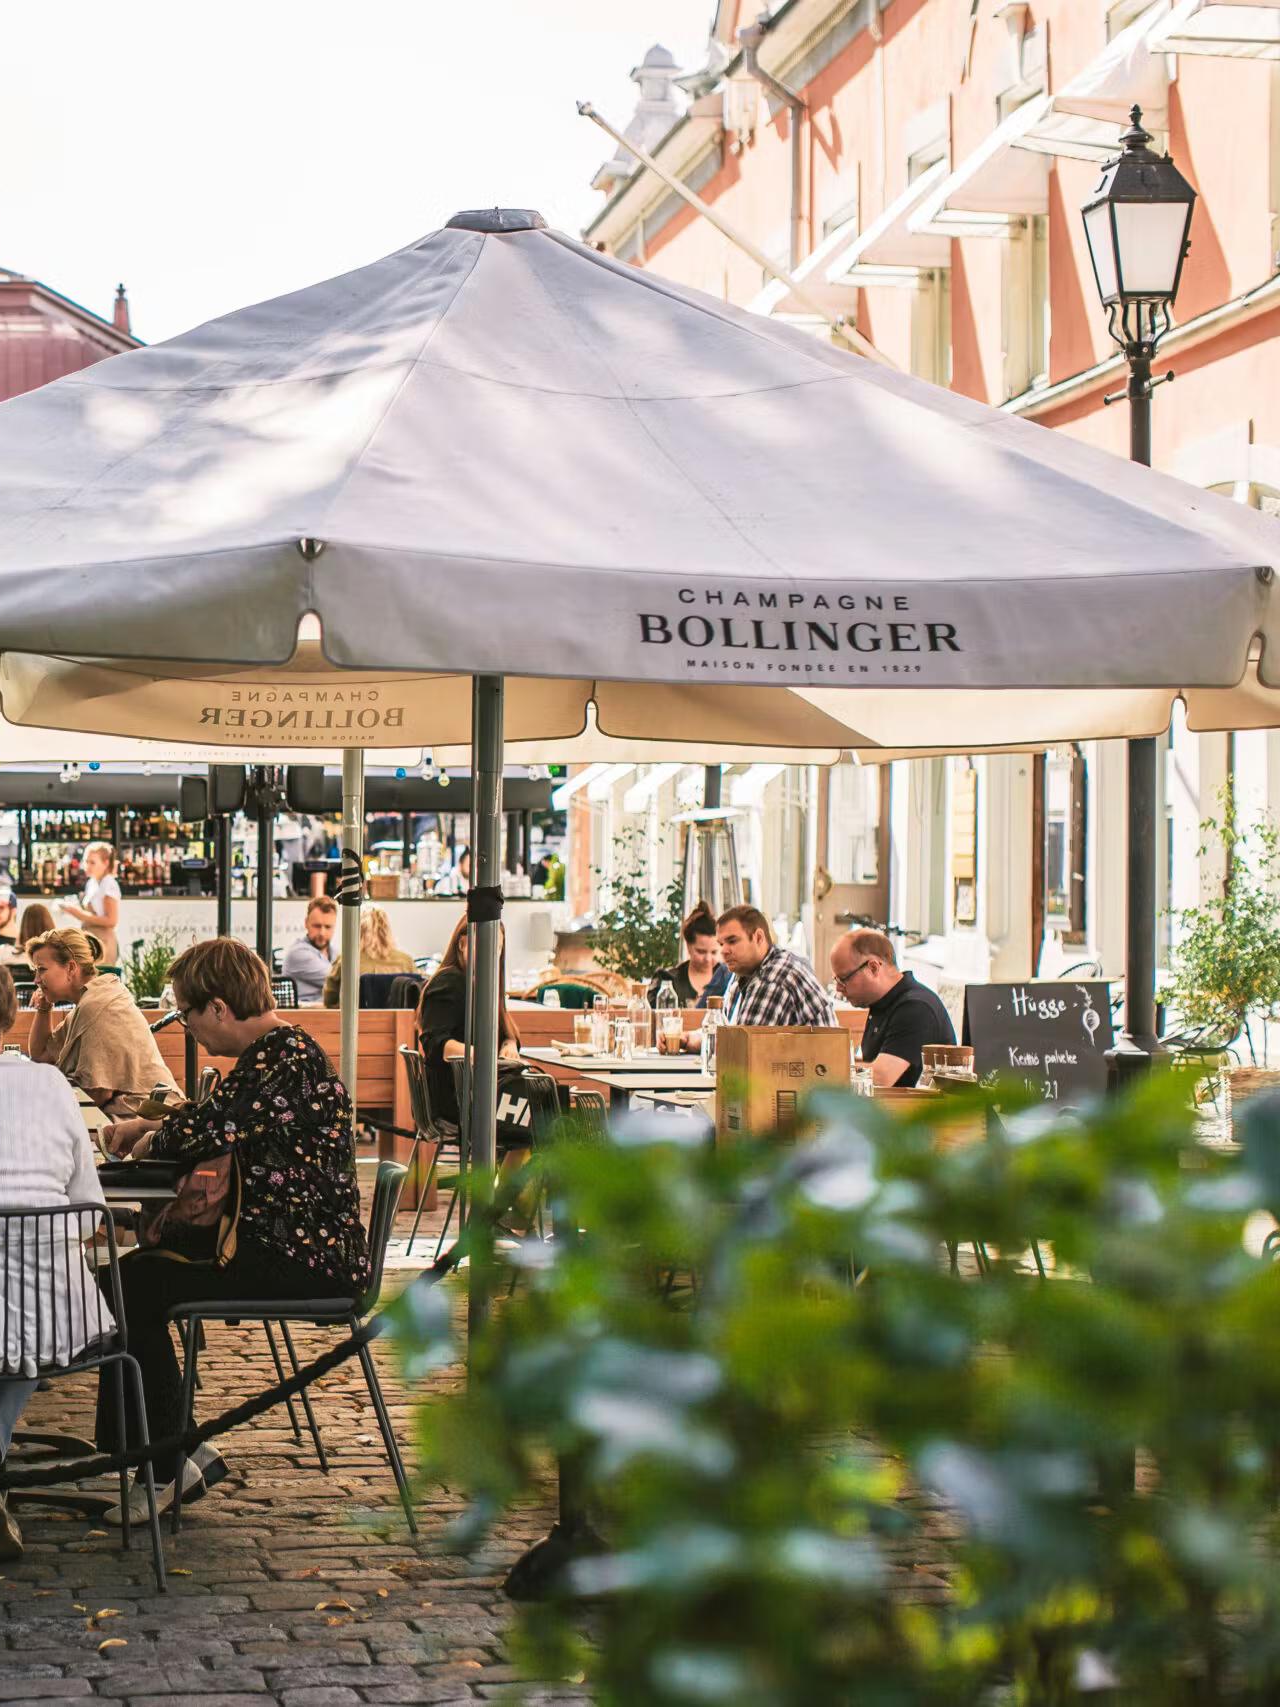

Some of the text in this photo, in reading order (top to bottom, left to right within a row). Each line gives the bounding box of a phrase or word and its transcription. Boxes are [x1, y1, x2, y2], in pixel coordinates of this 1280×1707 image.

[677, 588, 910, 611] CHAMPAGNE
[638, 613, 963, 653] BOLLINGER
[686, 659, 755, 670] MAISON
[848, 665, 869, 673] EN
[881, 665, 922, 673] 1829
